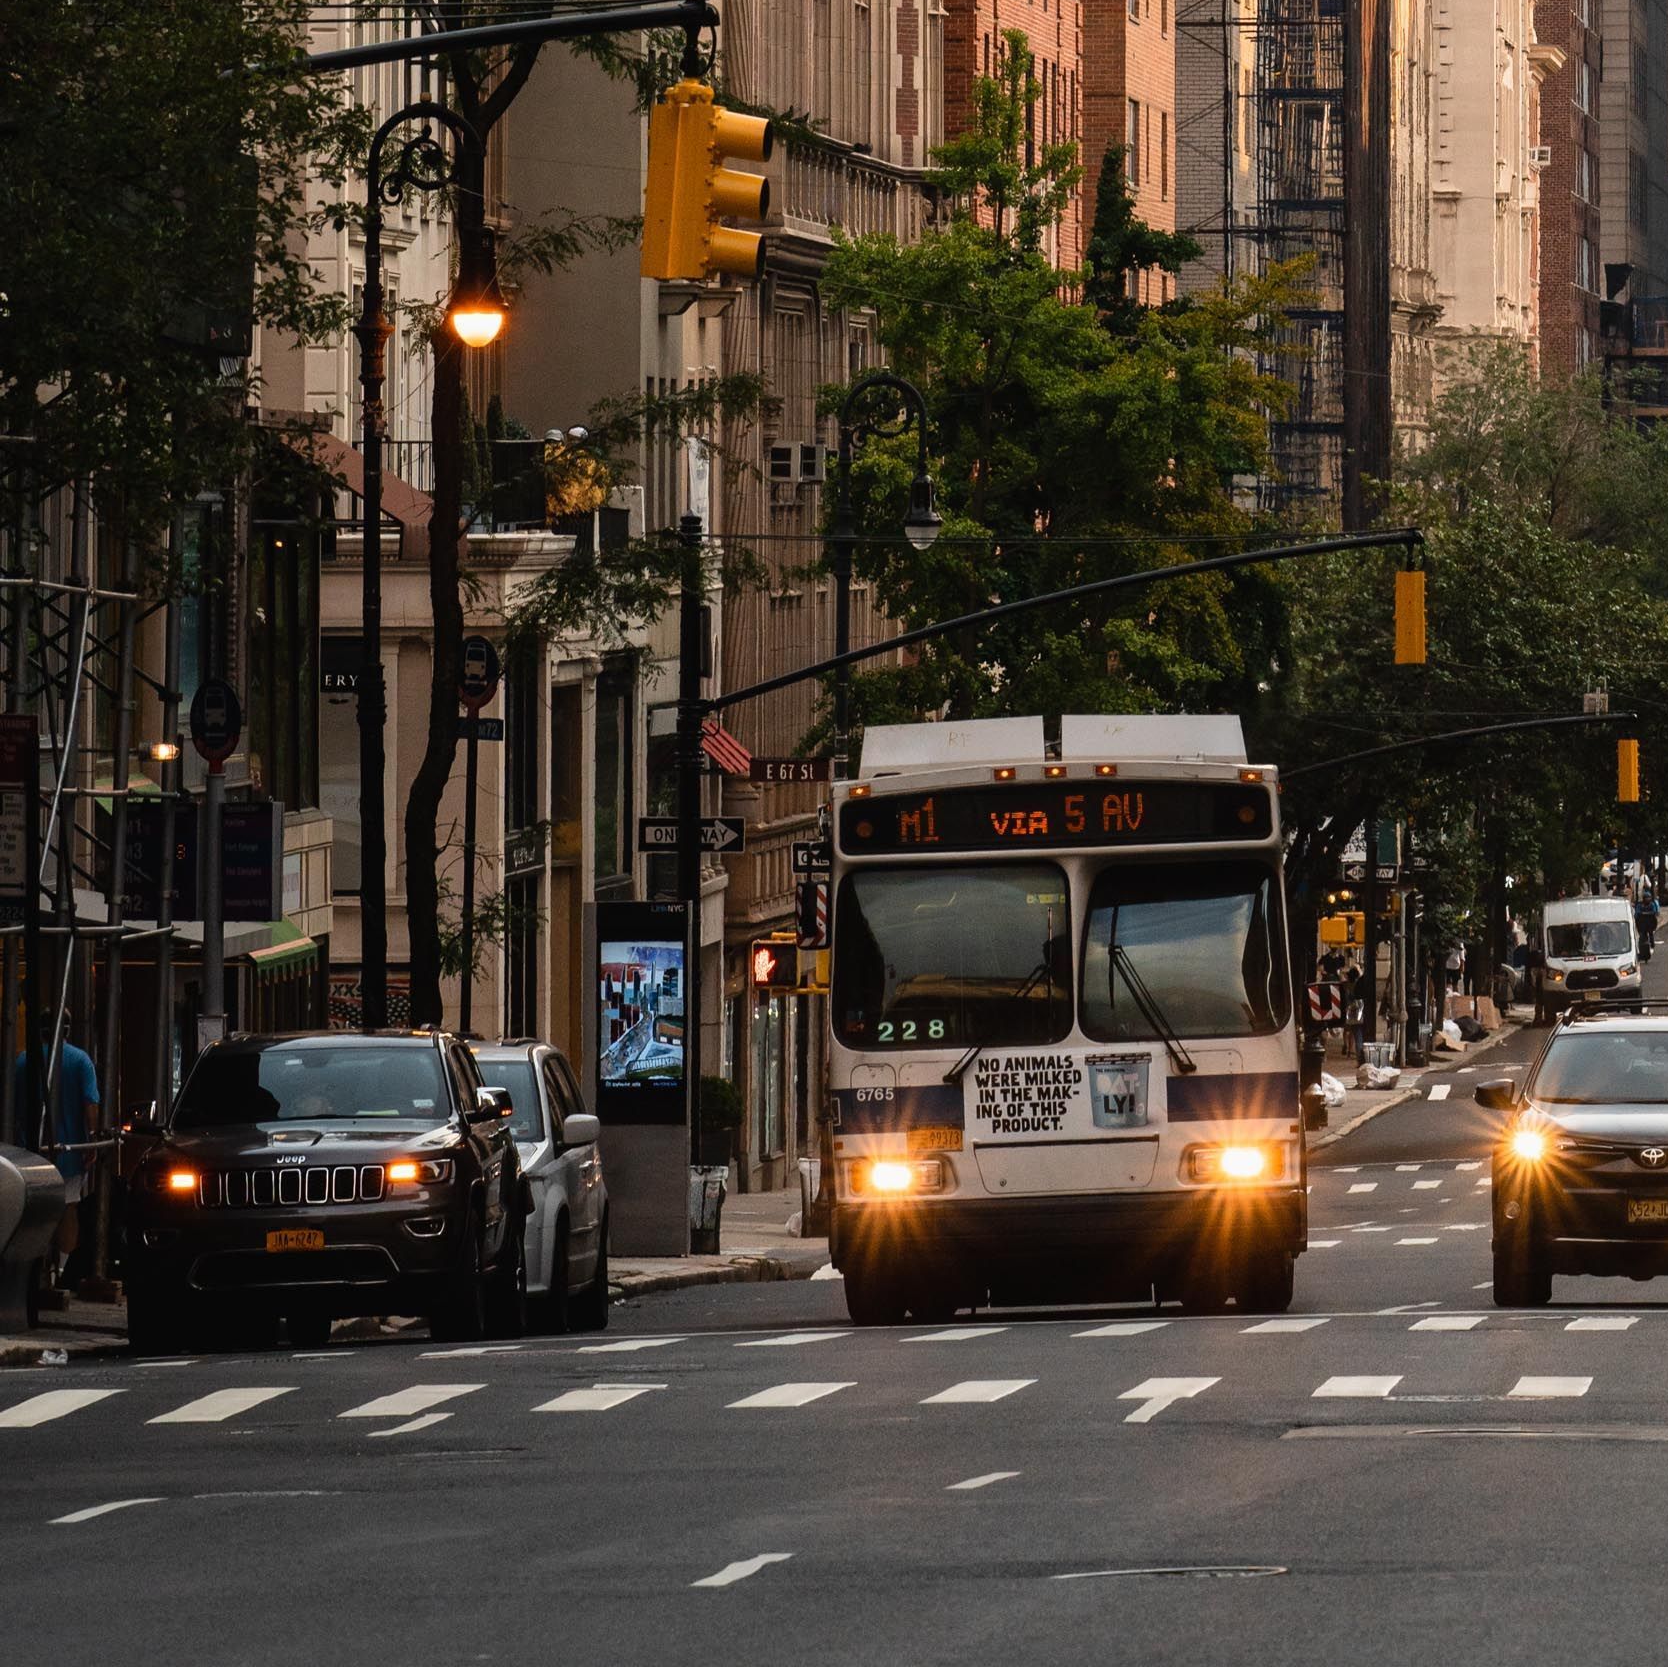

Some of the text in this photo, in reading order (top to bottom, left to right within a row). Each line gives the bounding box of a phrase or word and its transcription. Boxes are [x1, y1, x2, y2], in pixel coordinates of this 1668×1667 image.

[766, 764, 814, 780] E 67 St
[900, 793, 1144, 843] M1 VIA 5 AV
[653, 828, 678, 842] ON
[978, 1055, 1074, 1073] NO ANIMALS
[975, 1070, 1082, 1088] WERE MILKED
[856, 1087, 895, 1102] 6765
[979, 1085, 1080, 1104] IN THE MAK-
[976, 1101, 1068, 1119] ING OF THIS
[992, 1116, 1064, 1134] PRODUCT.
[276, 1154, 306, 1165] Jeep
